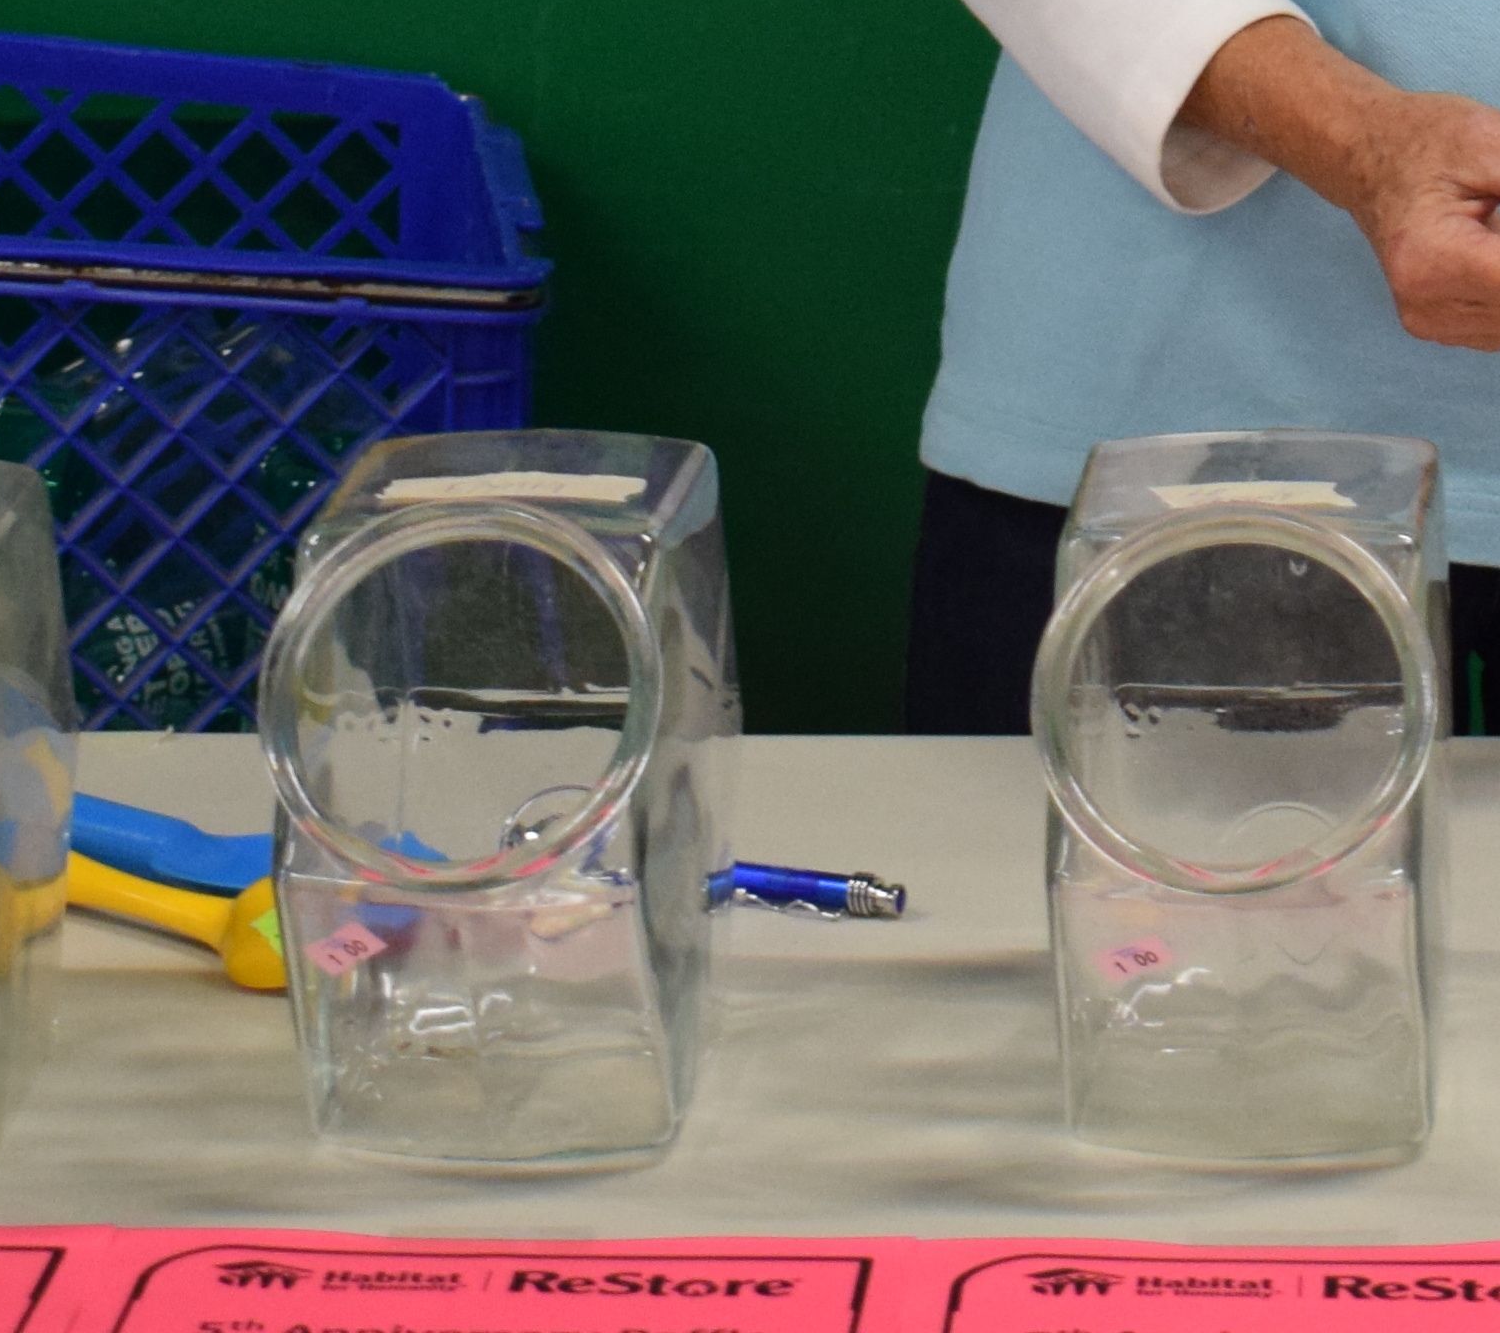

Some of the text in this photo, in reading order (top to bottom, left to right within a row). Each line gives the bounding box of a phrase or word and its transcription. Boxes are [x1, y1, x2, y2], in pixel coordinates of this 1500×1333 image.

[322, 1269, 796, 1297] Habitat ReStore
[1136, 1276, 1273, 1290] Habitat
